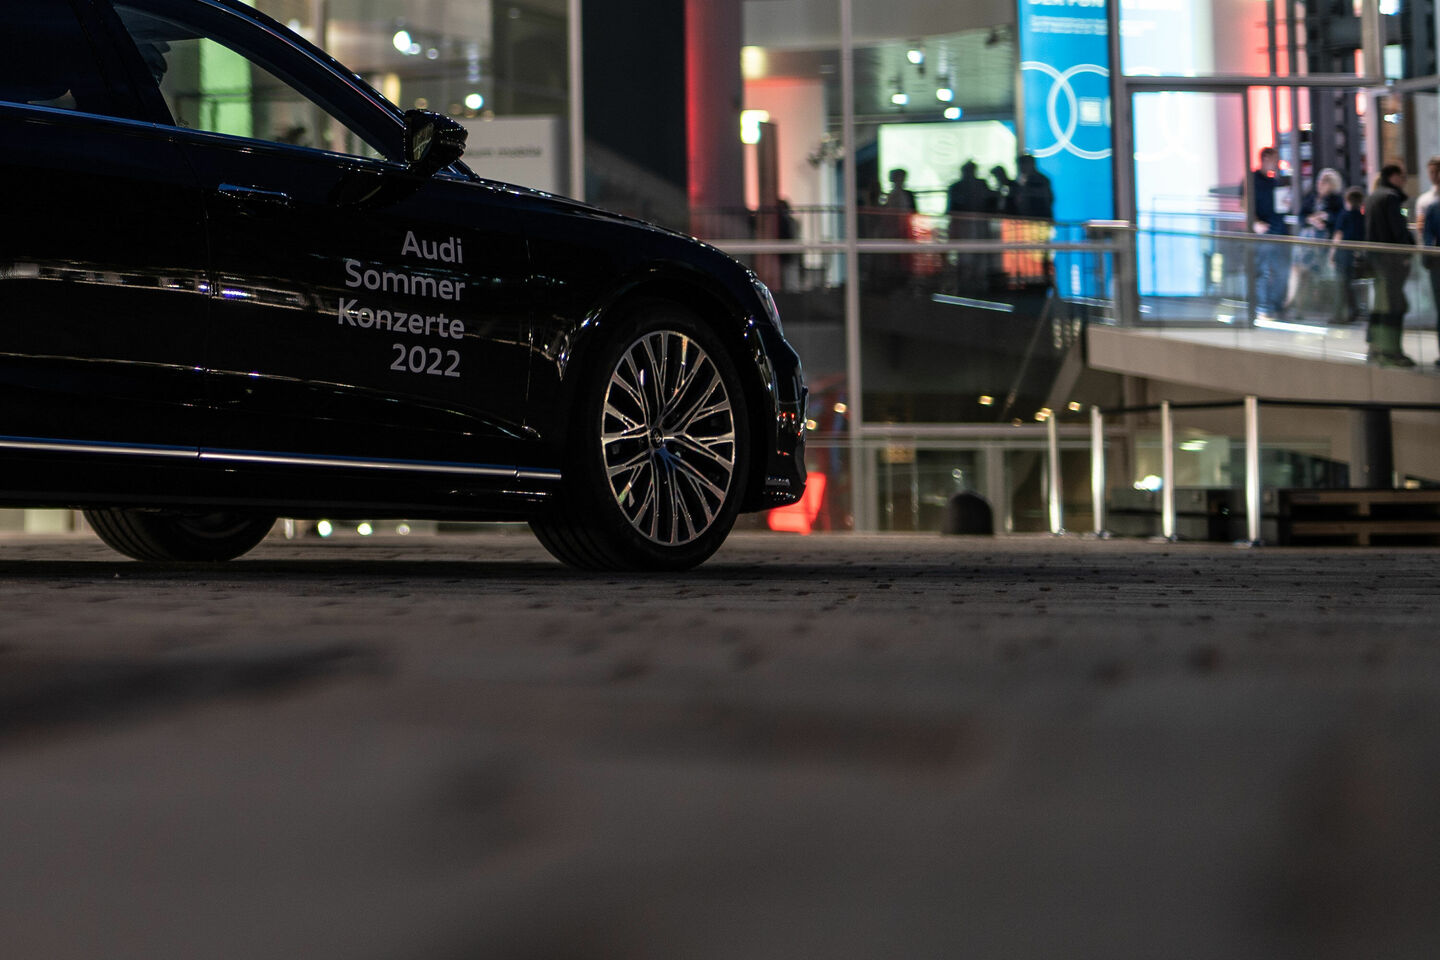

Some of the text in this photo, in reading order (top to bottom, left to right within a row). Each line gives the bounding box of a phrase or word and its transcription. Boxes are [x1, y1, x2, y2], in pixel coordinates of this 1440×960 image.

[401, 230, 463, 264] Audi
[345, 260, 466, 301] Sommer
[338, 297, 465, 339] Konzerte
[390, 343, 461, 378] 2022
